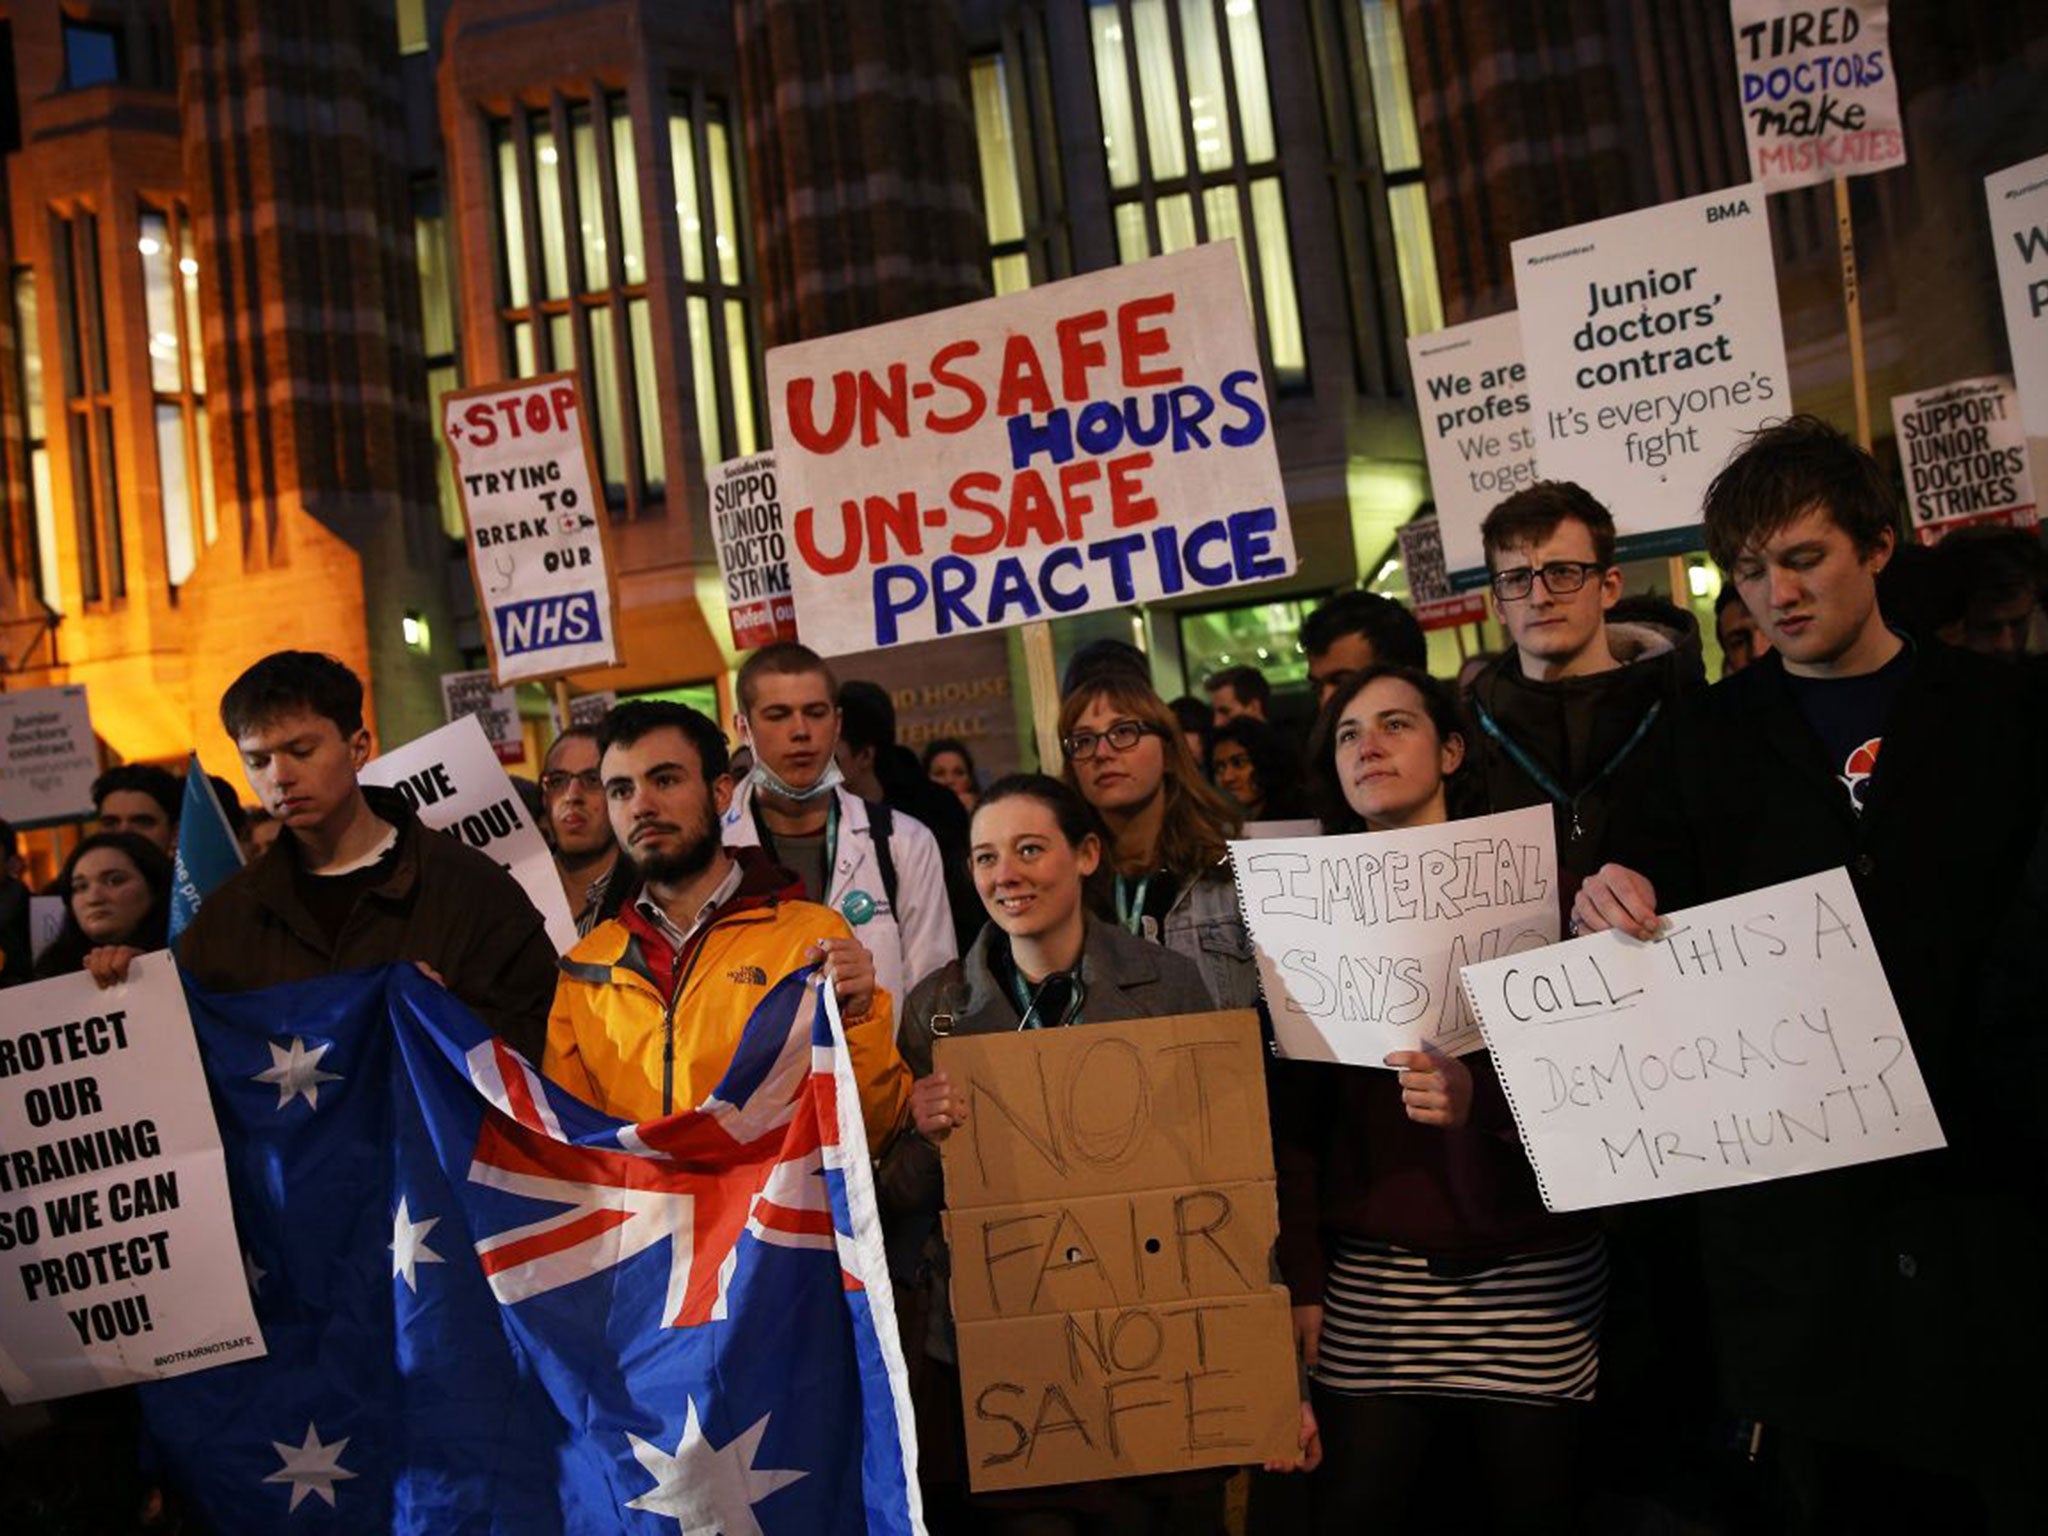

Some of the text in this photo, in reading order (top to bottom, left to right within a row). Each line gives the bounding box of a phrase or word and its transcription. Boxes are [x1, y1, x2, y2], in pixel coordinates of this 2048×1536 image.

[1740, 7, 1860, 61] TIRED
[1743, 51, 1884, 103] DOCTORS
[1749, 93, 1866, 136] make
[1758, 128, 1901, 176] MISKATES
[1706, 200, 1751, 223] BMA
[1588, 267, 1698, 317] Junior
[786, 293, 1184, 455] UN-SAFE
[1427, 363, 1526, 402] We are
[1576, 334, 1732, 389] contract
[464, 387, 577, 447] STOP
[1007, 371, 1266, 470] HOURS
[1437, 394, 1531, 438] profes
[1902, 395, 2007, 439] SUPPORT
[1457, 434, 1501, 462] We
[1625, 425, 1701, 467] fight
[1909, 426, 1990, 467] JUNIOR
[466, 461, 561, 497] TRYING
[539, 489, 577, 512] TO
[715, 472, 777, 513] SUPPO
[1470, 457, 1539, 493] toget
[1917, 477, 2017, 520] STRIKES
[476, 518, 549, 548] BREAK
[717, 502, 783, 543] JUNIOR
[795, 452, 1159, 576] UN-SAFE
[544, 547, 592, 573] OUR
[723, 533, 786, 572] DOCTO
[873, 507, 1287, 646] PRACTICE
[728, 562, 791, 602] STRIKE
[505, 598, 590, 652] NHS
[925, 676, 1007, 704] HOUSE
[1248, 838, 1548, 926] IMPERIAL
[1653, 914, 1787, 975] THIS
[1815, 892, 1857, 959] A
[1281, 948, 1430, 1026] SAYS
[1534, 1007, 1846, 1114] DEMOCRACY
[24, 1076, 102, 1128] OUR
[969, 1037, 1241, 1188] NOT
[0, 1119, 161, 1192] TRAINING
[1601, 1127, 1706, 1180] MR
[0, 1171, 180, 1252] SO WE CAN
[20, 1231, 170, 1302] PROTECT
[981, 1190, 1254, 1314] FAIR
[67, 1294, 154, 1347] YOU!
[1063, 1303, 1249, 1386] NOT
[153, 1335, 255, 1367] #NOTFAIRNOTSAFE
[974, 1369, 1255, 1470] SAFE
